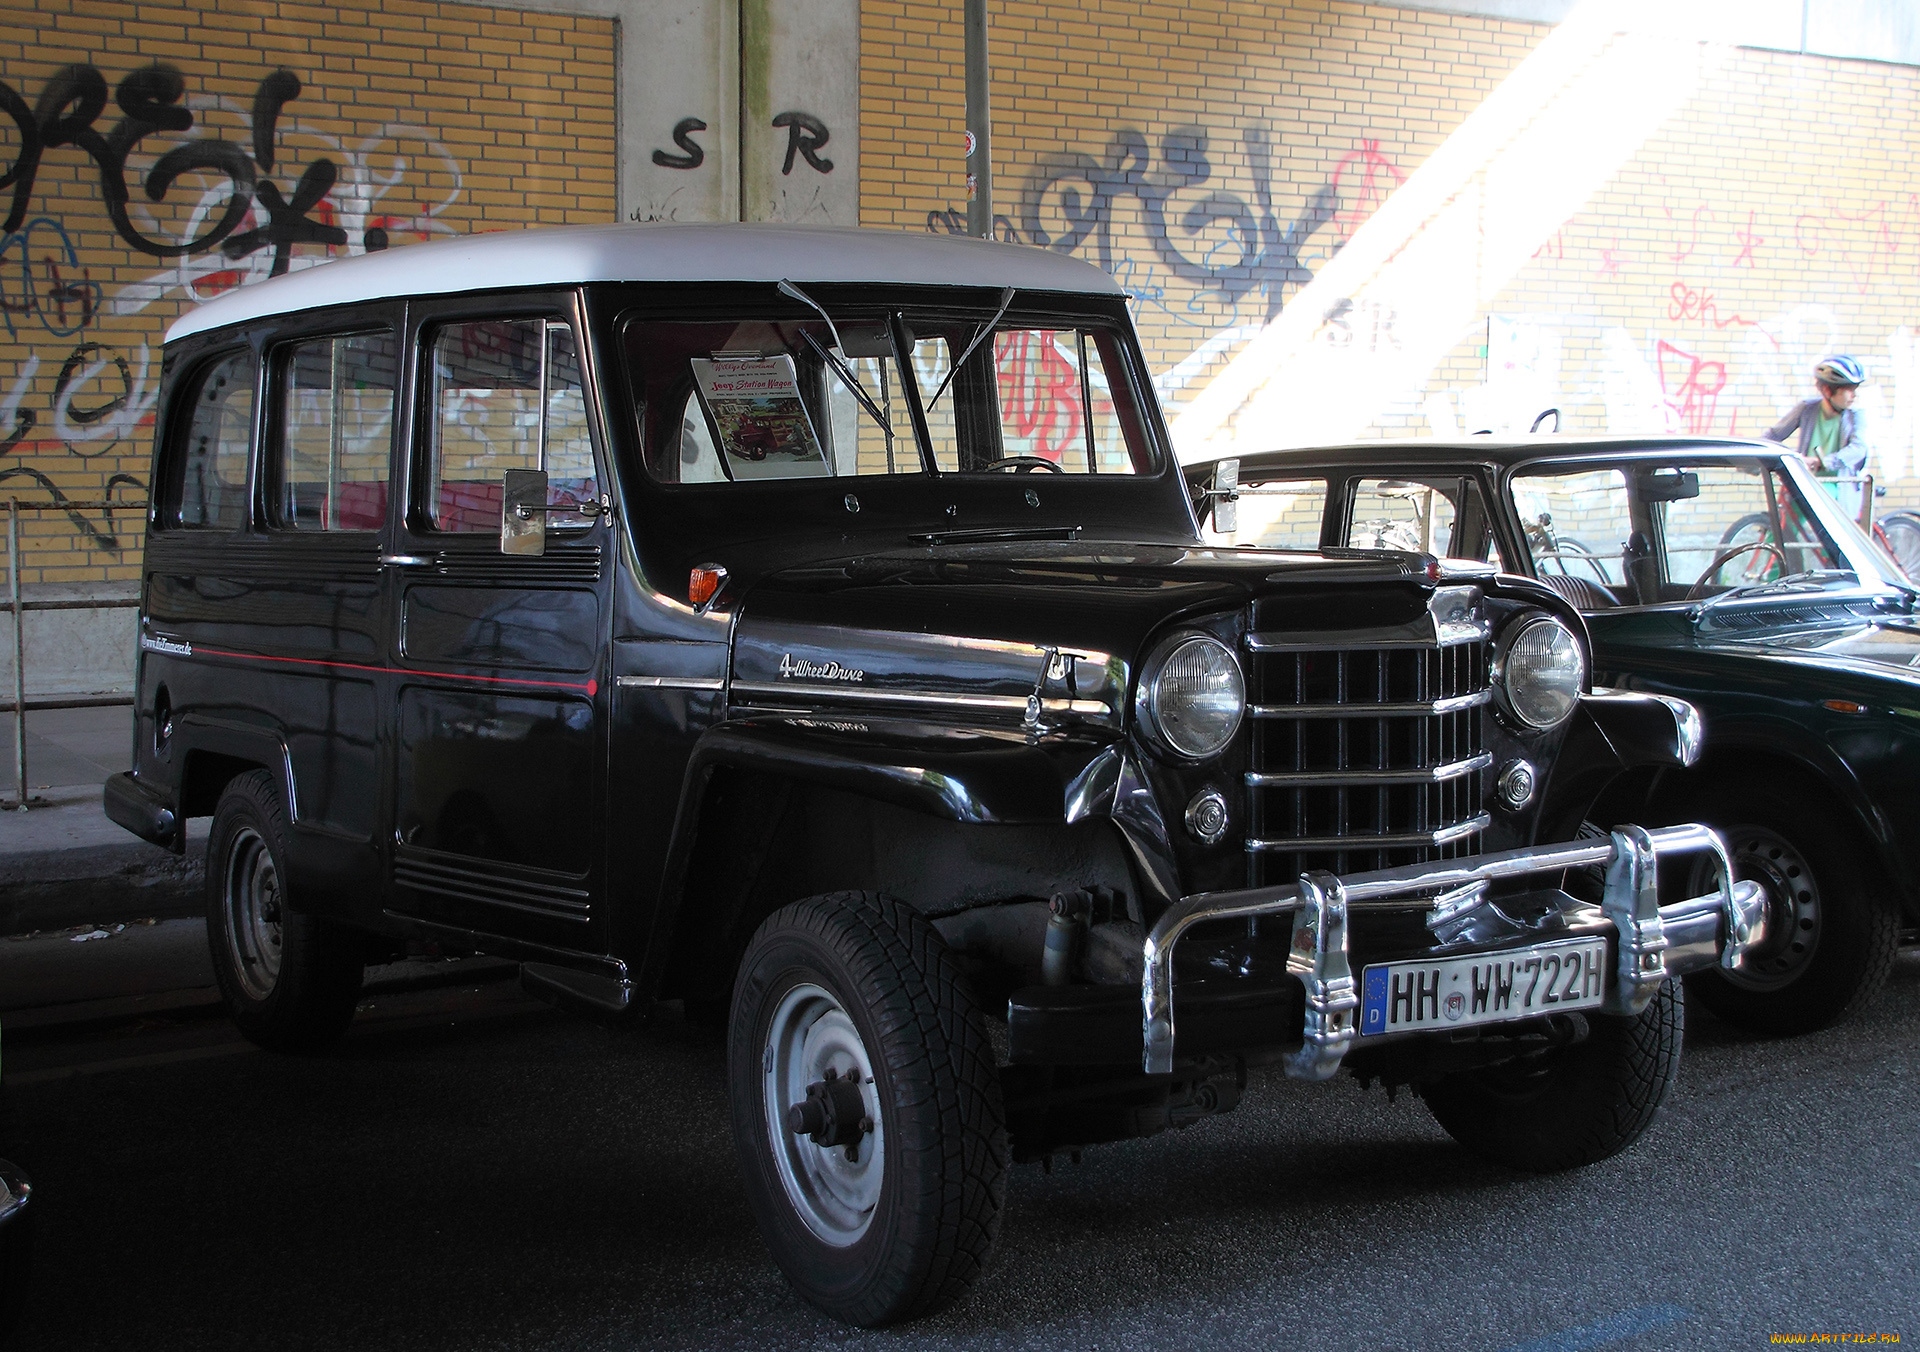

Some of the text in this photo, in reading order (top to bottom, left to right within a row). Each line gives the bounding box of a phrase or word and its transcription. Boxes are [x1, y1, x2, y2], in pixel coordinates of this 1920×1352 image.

[652, 111, 835, 176] S R
[735, 379, 766, 390] Station
[768, 379, 793, 390] Wagon
[1390, 947, 1604, 1024] HH WW 722H
[1370, 1008, 1379, 1024] D
